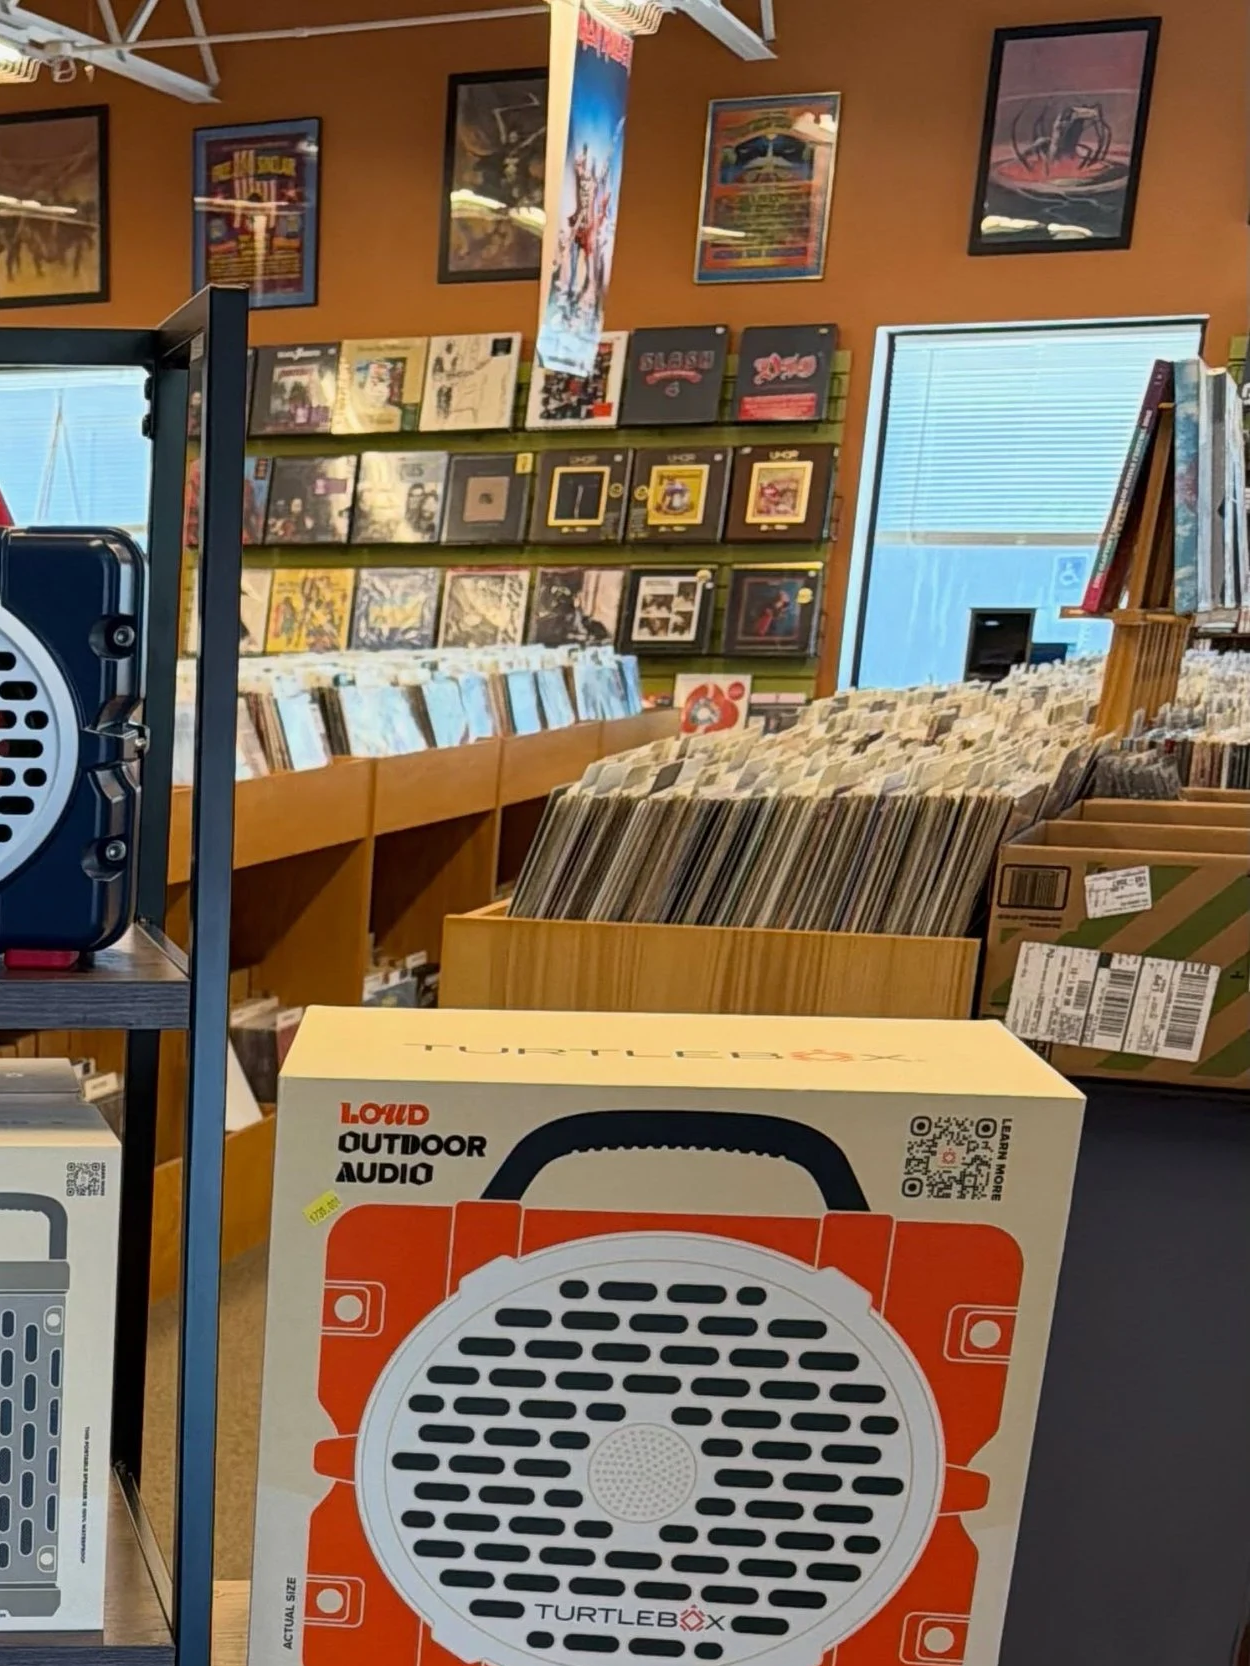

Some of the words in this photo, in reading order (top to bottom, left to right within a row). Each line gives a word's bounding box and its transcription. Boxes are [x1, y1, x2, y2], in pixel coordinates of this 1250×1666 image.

[639, 351, 715, 371] SLASH
[339, 1101, 430, 1126] LOUD
[338, 1130, 487, 1158] OUTDOOR
[998, 1117, 1013, 1161] LEARN
[335, 1161, 434, 1187] AUDIO
[991, 1164, 1006, 1202] MORE
[286, 1576, 298, 1603] SIZE
[282, 1605, 295, 1650] ACTUAL
[534, 1603, 726, 1633] TURTLEBOX
